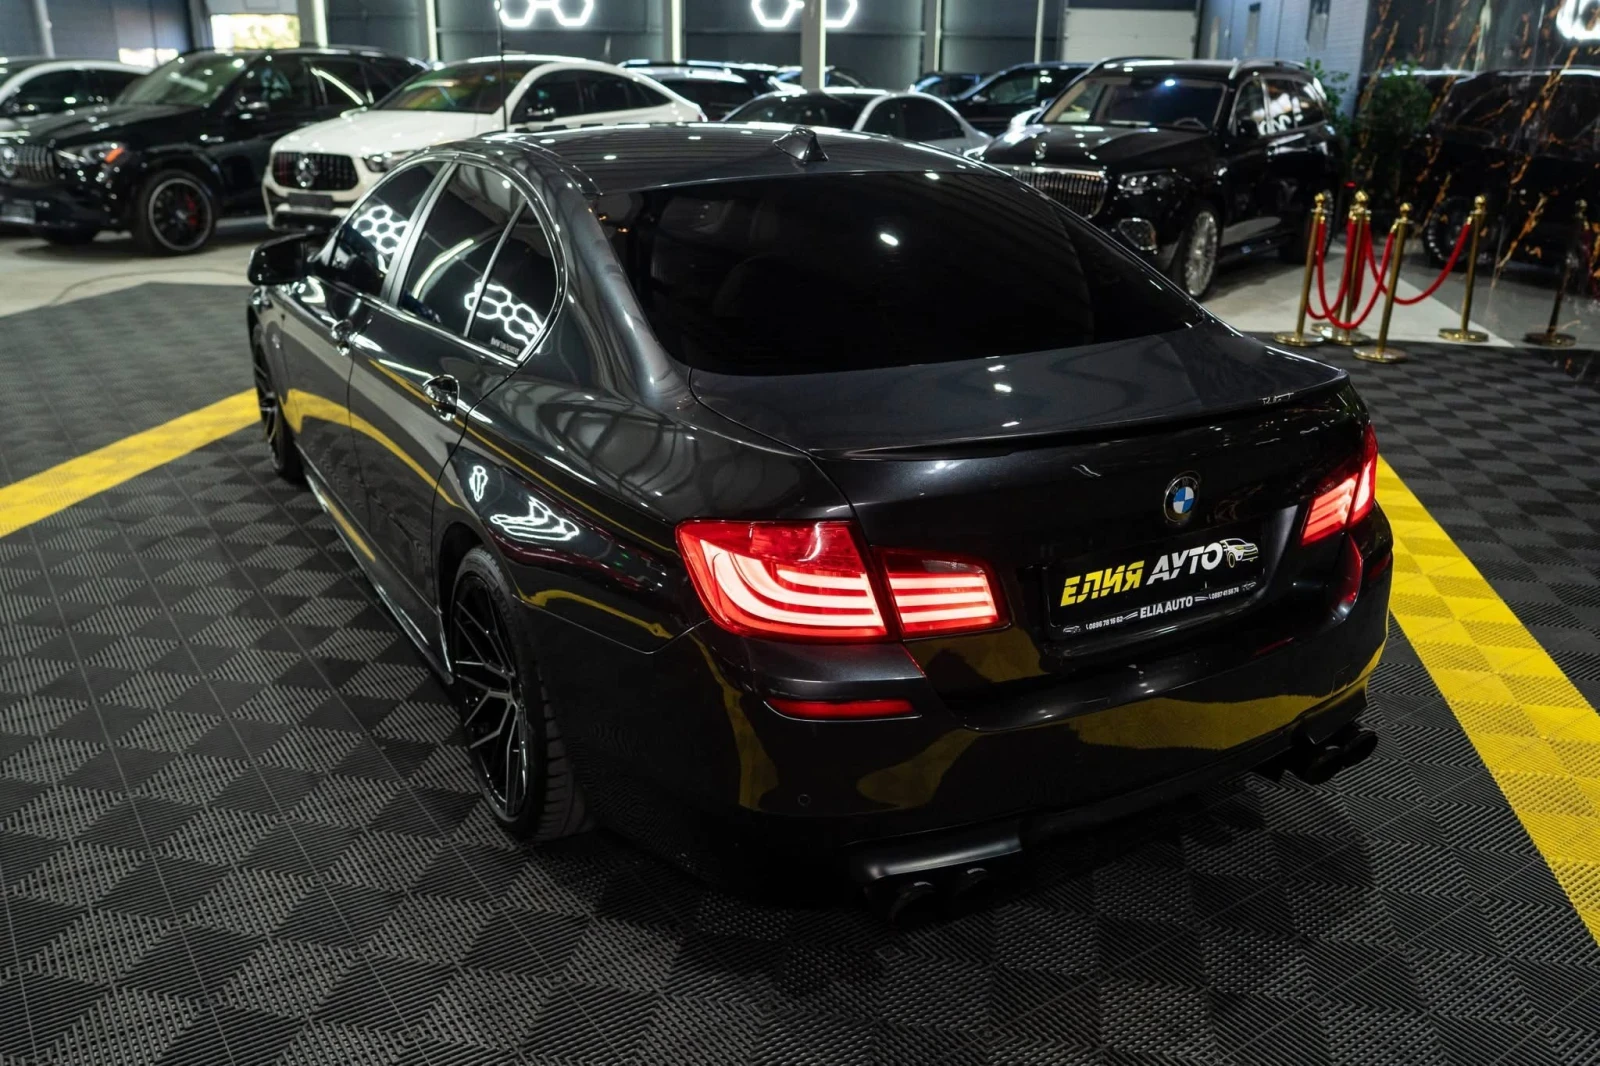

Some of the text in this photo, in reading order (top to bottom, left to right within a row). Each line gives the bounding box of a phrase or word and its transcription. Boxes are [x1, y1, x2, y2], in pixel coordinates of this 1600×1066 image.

[1060, 542, 1223, 607] ЕЛИЯ АУТО
[1140, 602, 1164, 619] ELIA
[1165, 595, 1194, 612] AUTO
